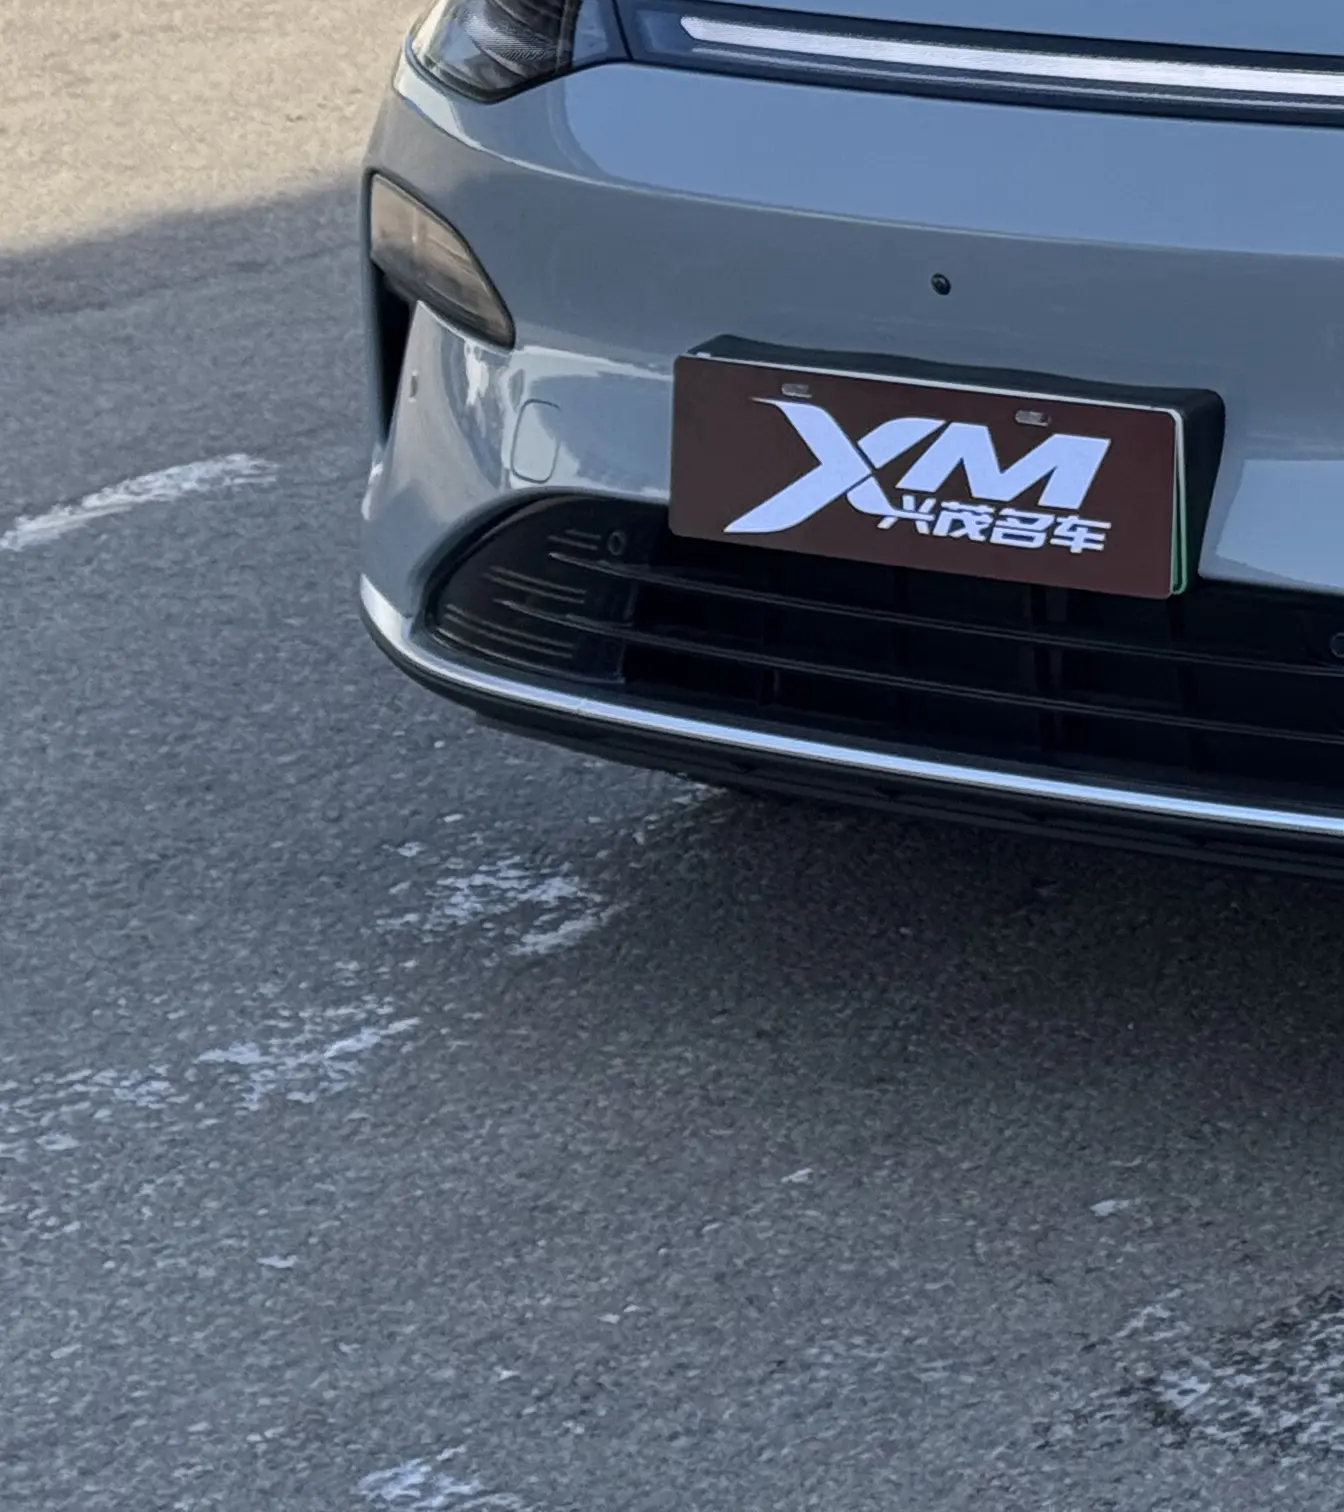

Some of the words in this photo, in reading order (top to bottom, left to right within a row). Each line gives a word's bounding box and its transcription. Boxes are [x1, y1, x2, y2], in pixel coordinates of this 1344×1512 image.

[723, 397, 1111, 534] XM
[877, 494, 1112, 554] 兴茂名车
